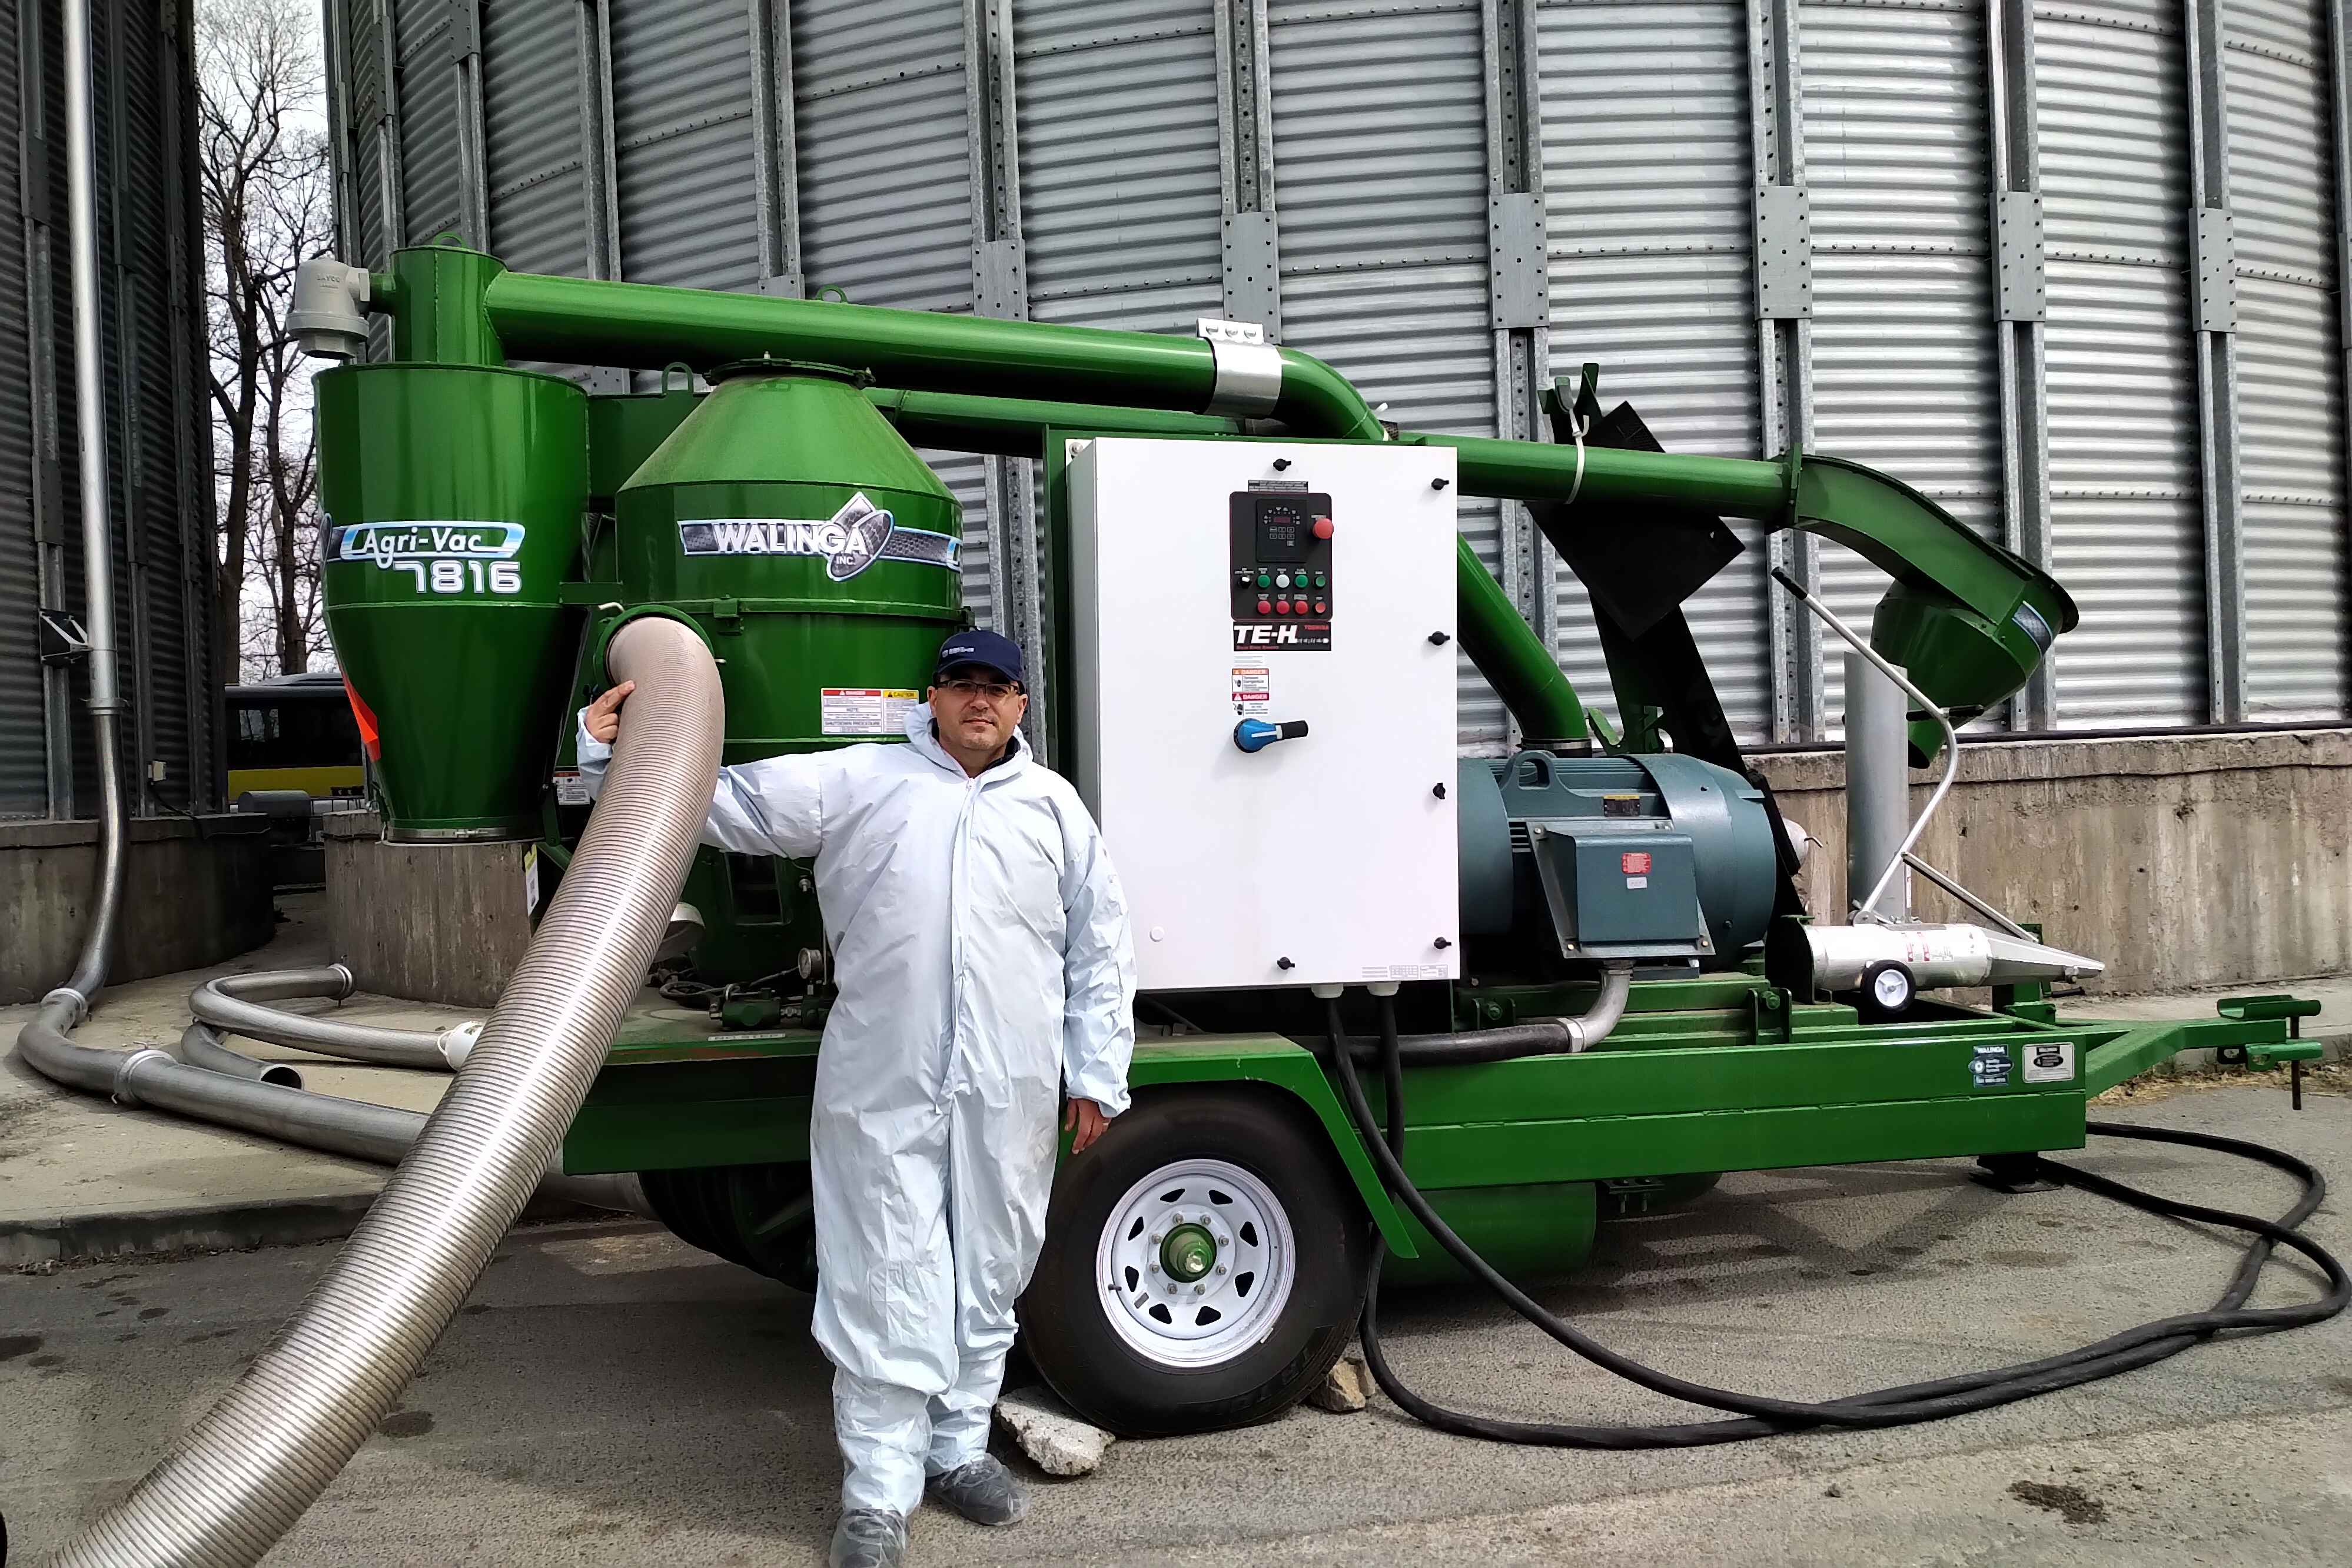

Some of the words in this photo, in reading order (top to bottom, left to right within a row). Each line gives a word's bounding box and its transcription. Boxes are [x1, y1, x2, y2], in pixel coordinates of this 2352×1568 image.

[363, 527, 482, 569] Agri-Vac
[713, 522, 868, 555] WALINGA
[393, 560, 522, 593] 7816
[836, 556, 856, 566] INC.
[1234, 625, 1297, 644] TE-H
